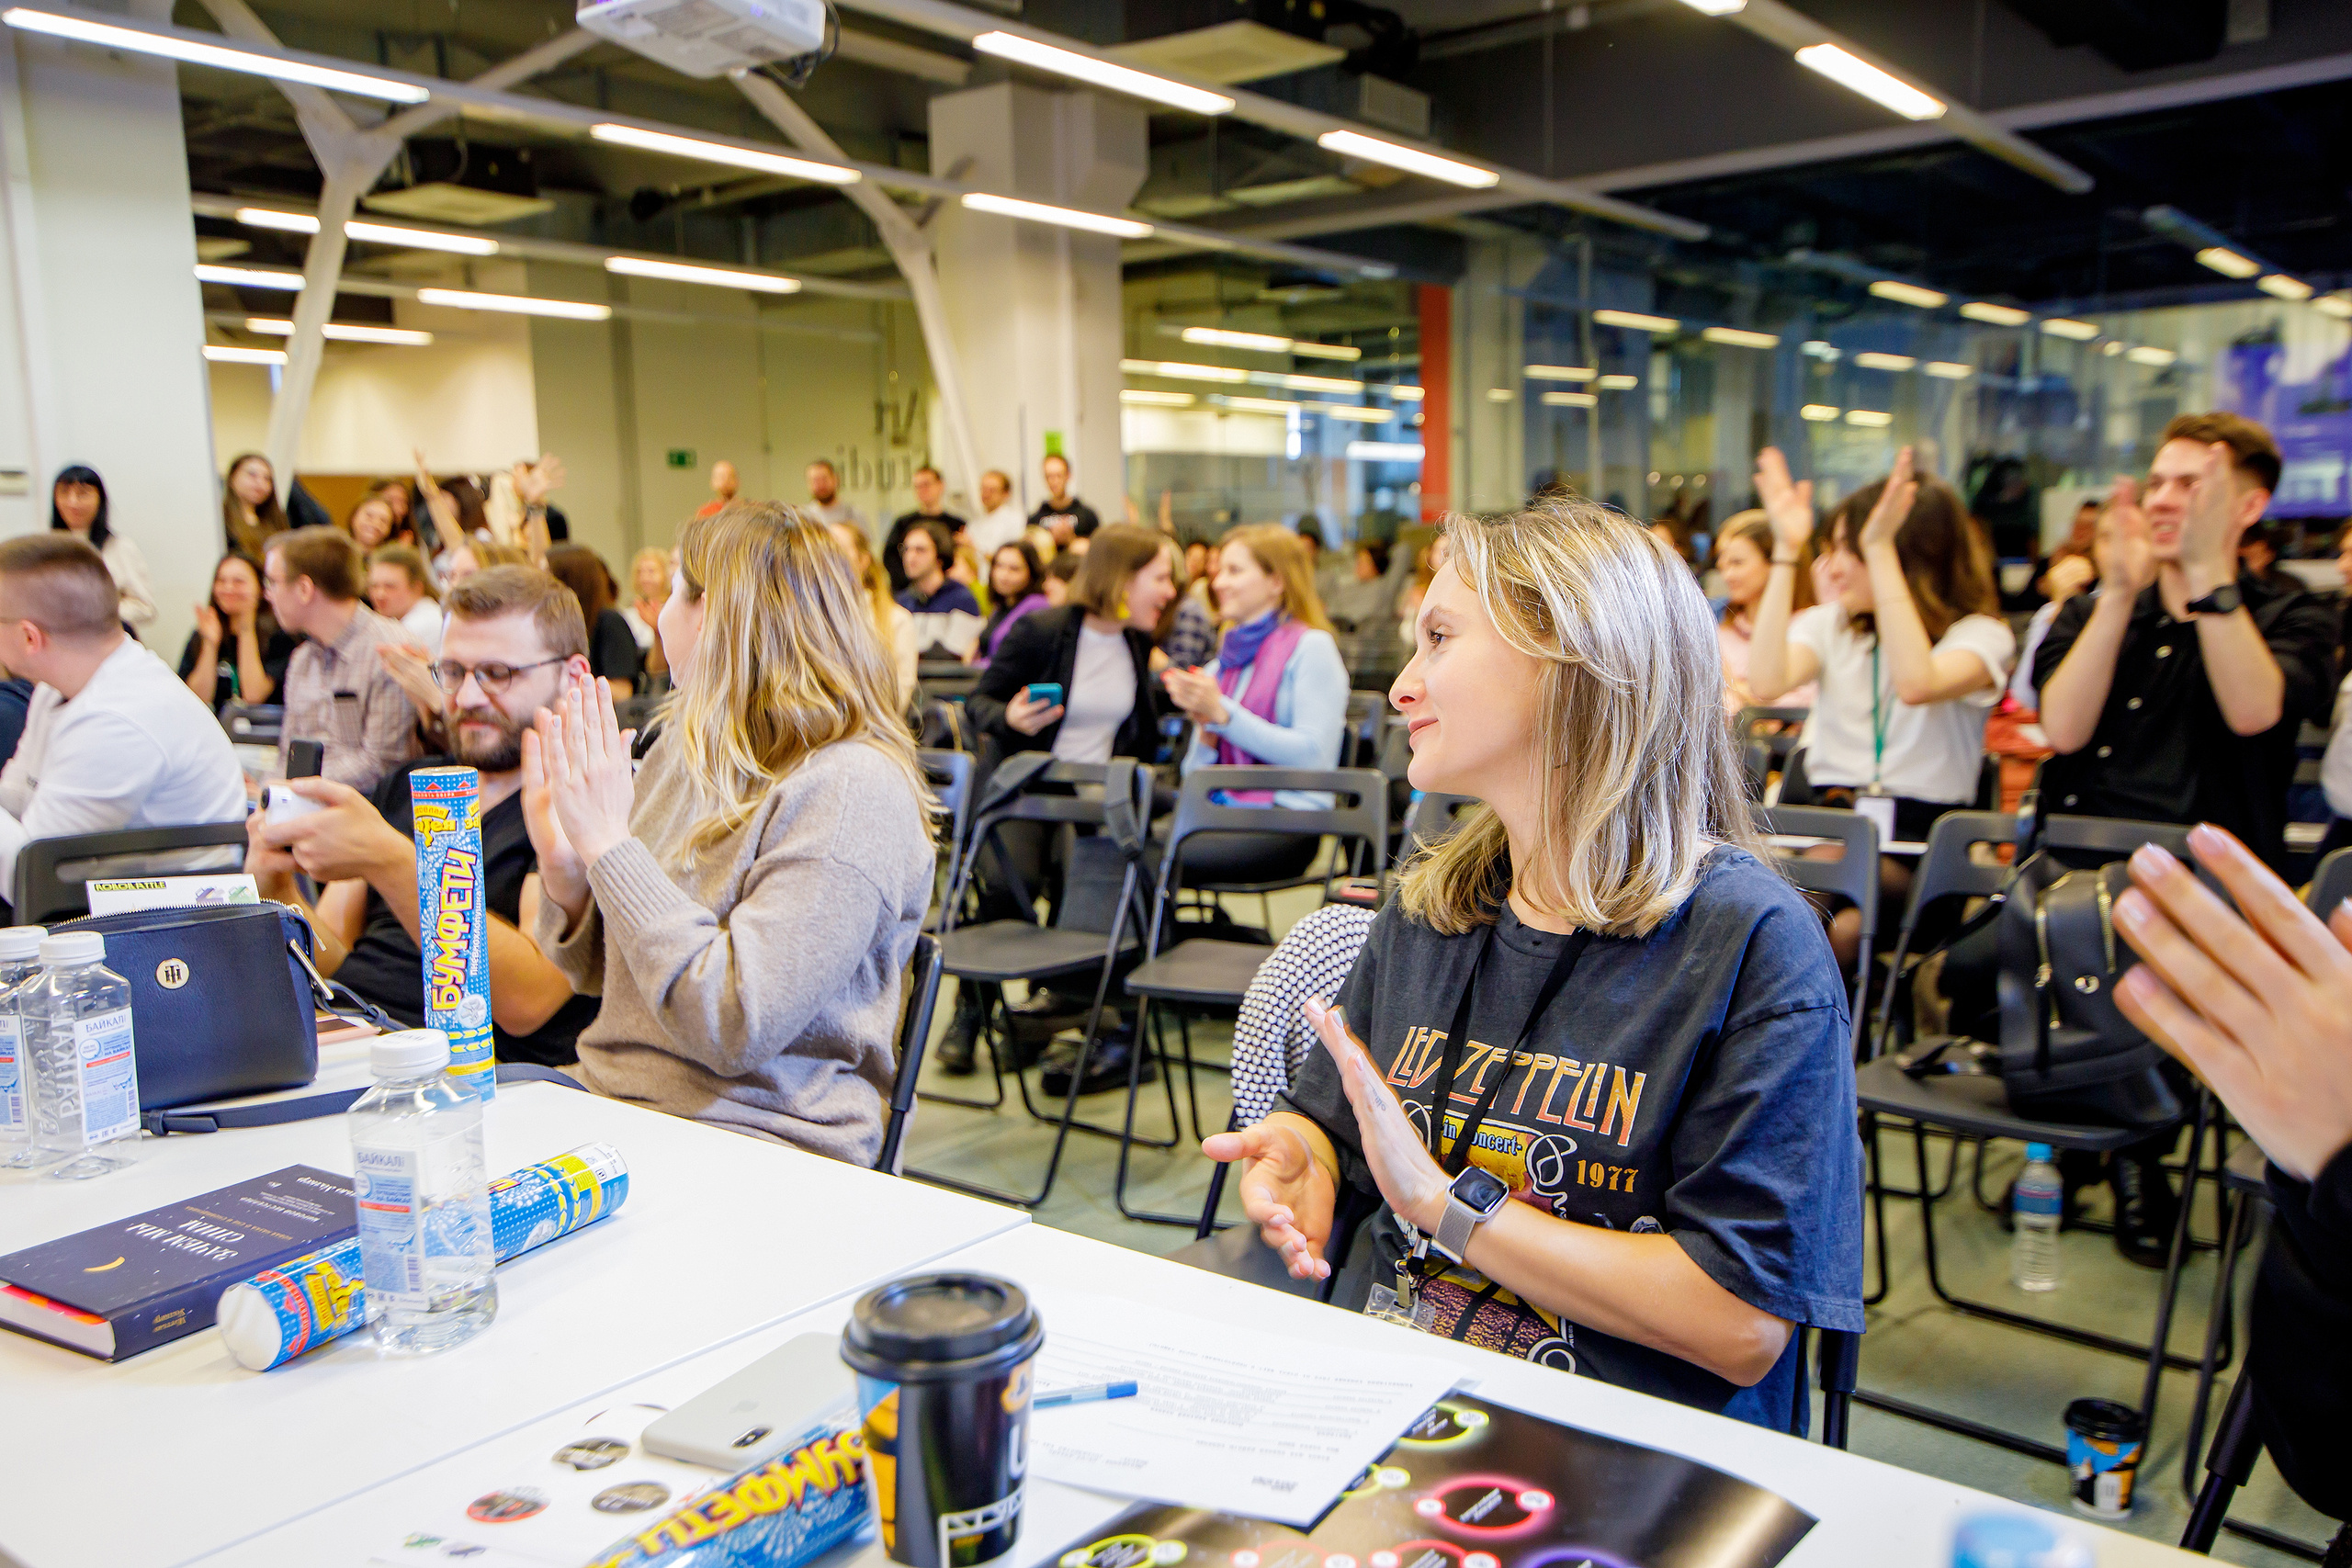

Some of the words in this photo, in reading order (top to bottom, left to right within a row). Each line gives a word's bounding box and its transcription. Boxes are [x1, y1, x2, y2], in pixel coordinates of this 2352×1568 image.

[431, 847, 478, 1011] БУМФЕТИ
[85, 1014, 125, 1033] БАЙКАЛ
[1386, 1026, 1449, 1089] LED
[1431, 1040, 1646, 1147] ZEPPELIN
[1442, 1118, 1457, 1140] in
[1471, 1131, 1522, 1156] ncert-
[357, 1152, 402, 1168] БАЙКАЛ
[1577, 1159, 1639, 1193] 1977
[125, 1222, 174, 1240] МЫ
[177, 1219, 245, 1243] СПИМ
[162, 1234, 239, 1261] ЗАЧЕМ
